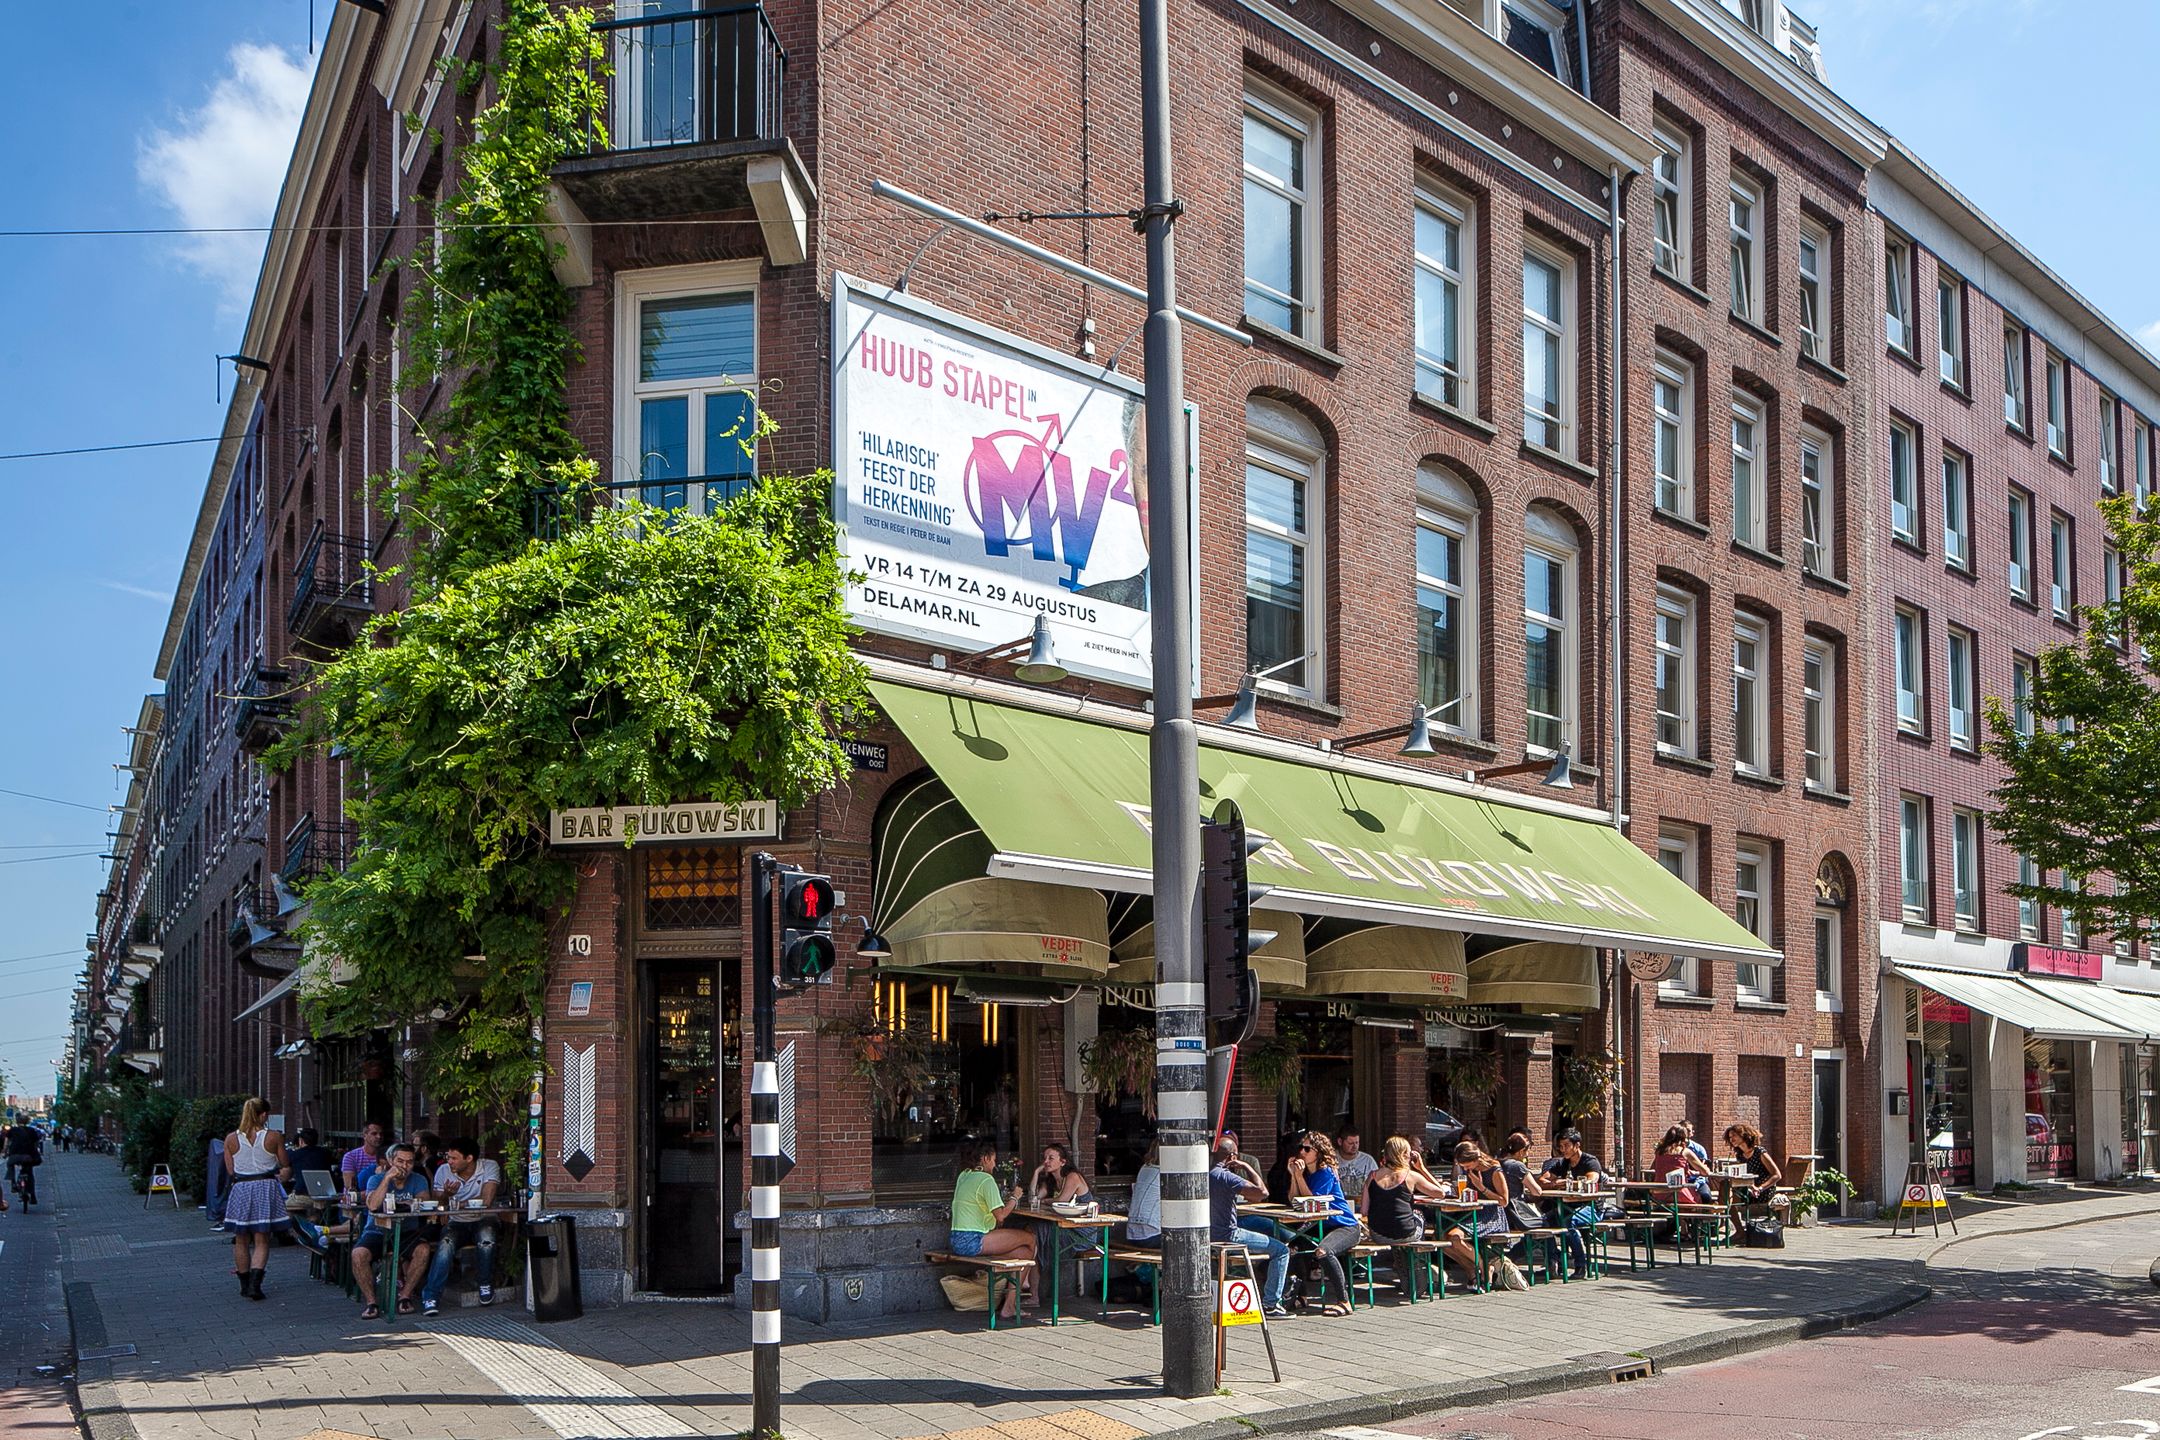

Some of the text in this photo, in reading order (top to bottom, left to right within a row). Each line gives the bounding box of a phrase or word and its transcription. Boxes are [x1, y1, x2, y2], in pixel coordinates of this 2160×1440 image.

[861, 331, 1037, 423] HUUB STAPEL IN
[910, 471, 936, 496] DER
[863, 515, 880, 528] TEKST
[881, 520, 889, 530] EN
[889, 522, 906, 535] REGIE
[910, 527, 928, 540] PETER
[928, 533, 936, 542] DE
[936, 535, 951, 546] BAAN
[865, 554, 1097, 623] VR 14 T/M ZA 29 AUGUSTUS
[864, 587, 980, 627] DELAMAR.NL
[1084, 641, 1140, 660] JE ZIET MEER IN HET
[868, 760, 885, 768] OOST
[561, 807, 766, 839] BAR BUKOWSKI
[1301, 837, 1660, 923] BUKOWSKI
[570, 937, 588, 953] 10
[1041, 937, 1083, 953] VEDETT
[2045, 948, 2089, 965] CITY SILKS
[1948, 1149, 1972, 1167] SILKS
[2025, 1144, 2074, 1163] CITY SILKS
